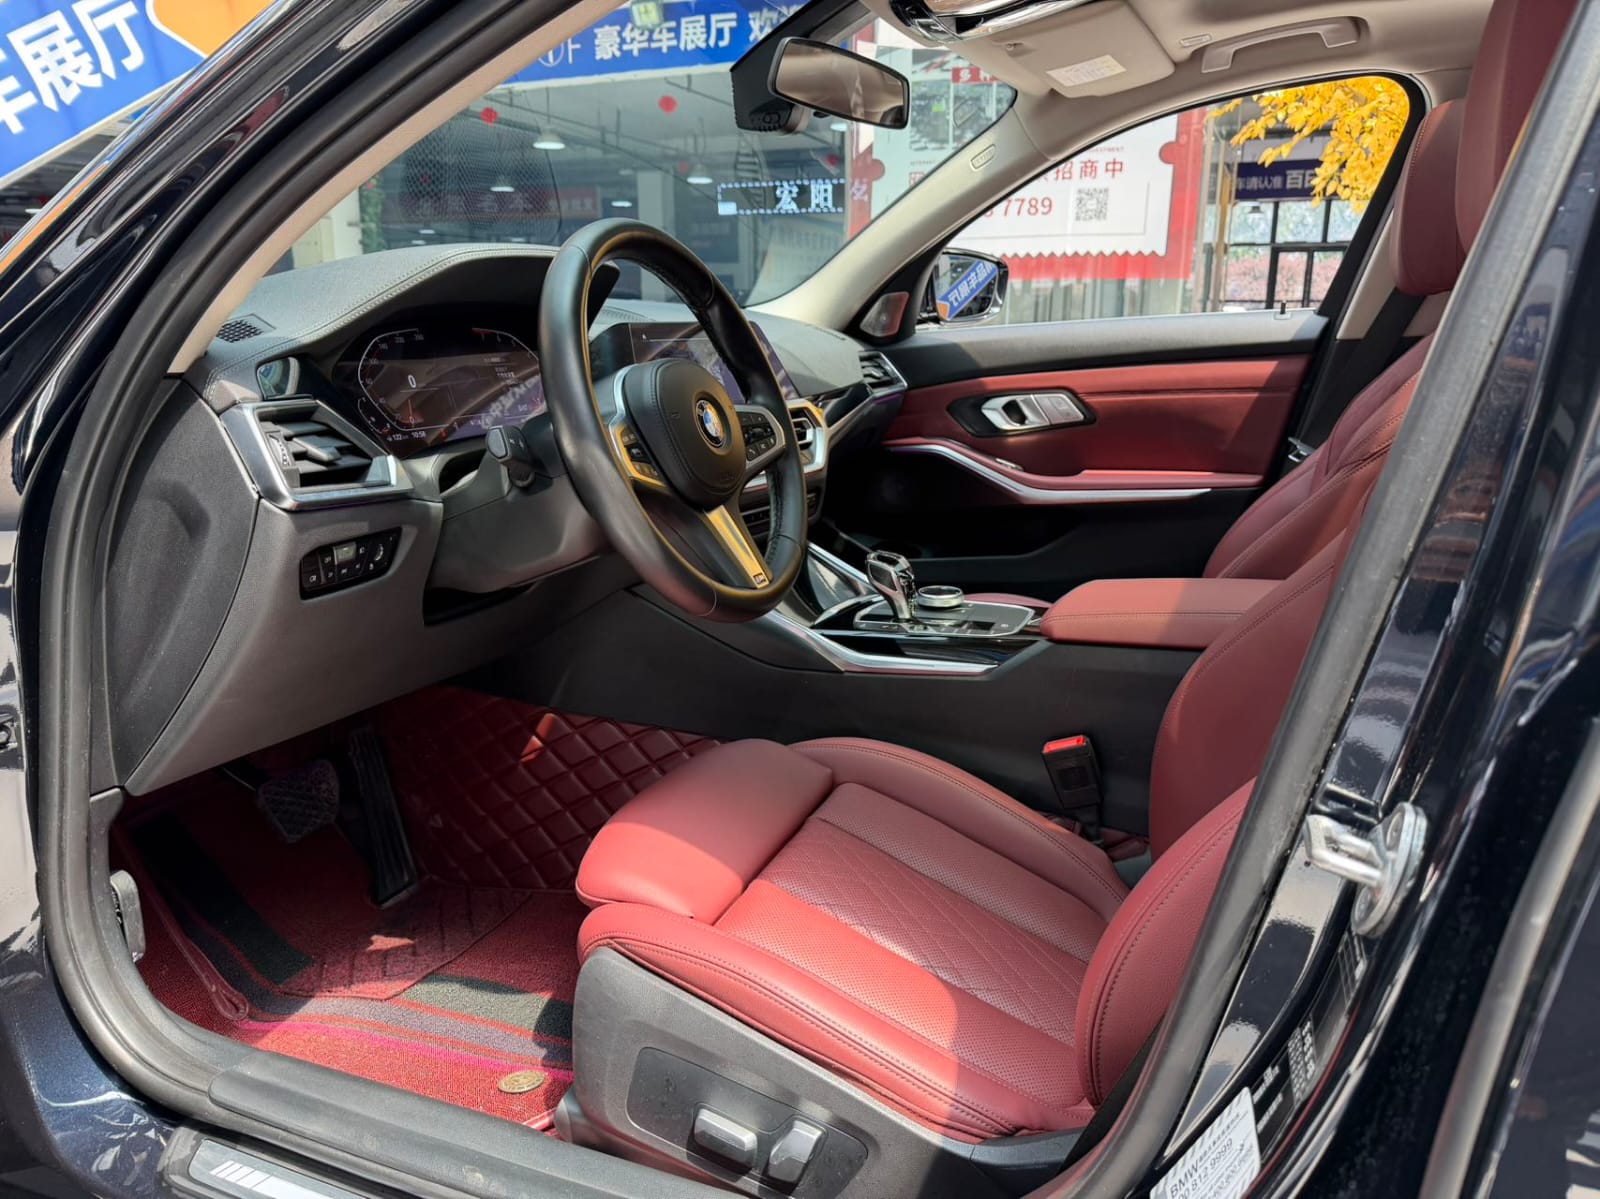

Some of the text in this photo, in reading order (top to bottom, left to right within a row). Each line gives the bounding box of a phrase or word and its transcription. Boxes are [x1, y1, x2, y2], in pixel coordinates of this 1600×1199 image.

[594, 12, 737, 61] 豪华车展厅
[749, 4, 799, 42] 欢
[1040, 158, 1124, 181] 招商中
[1170, 1159, 1199, 1198] BMW
